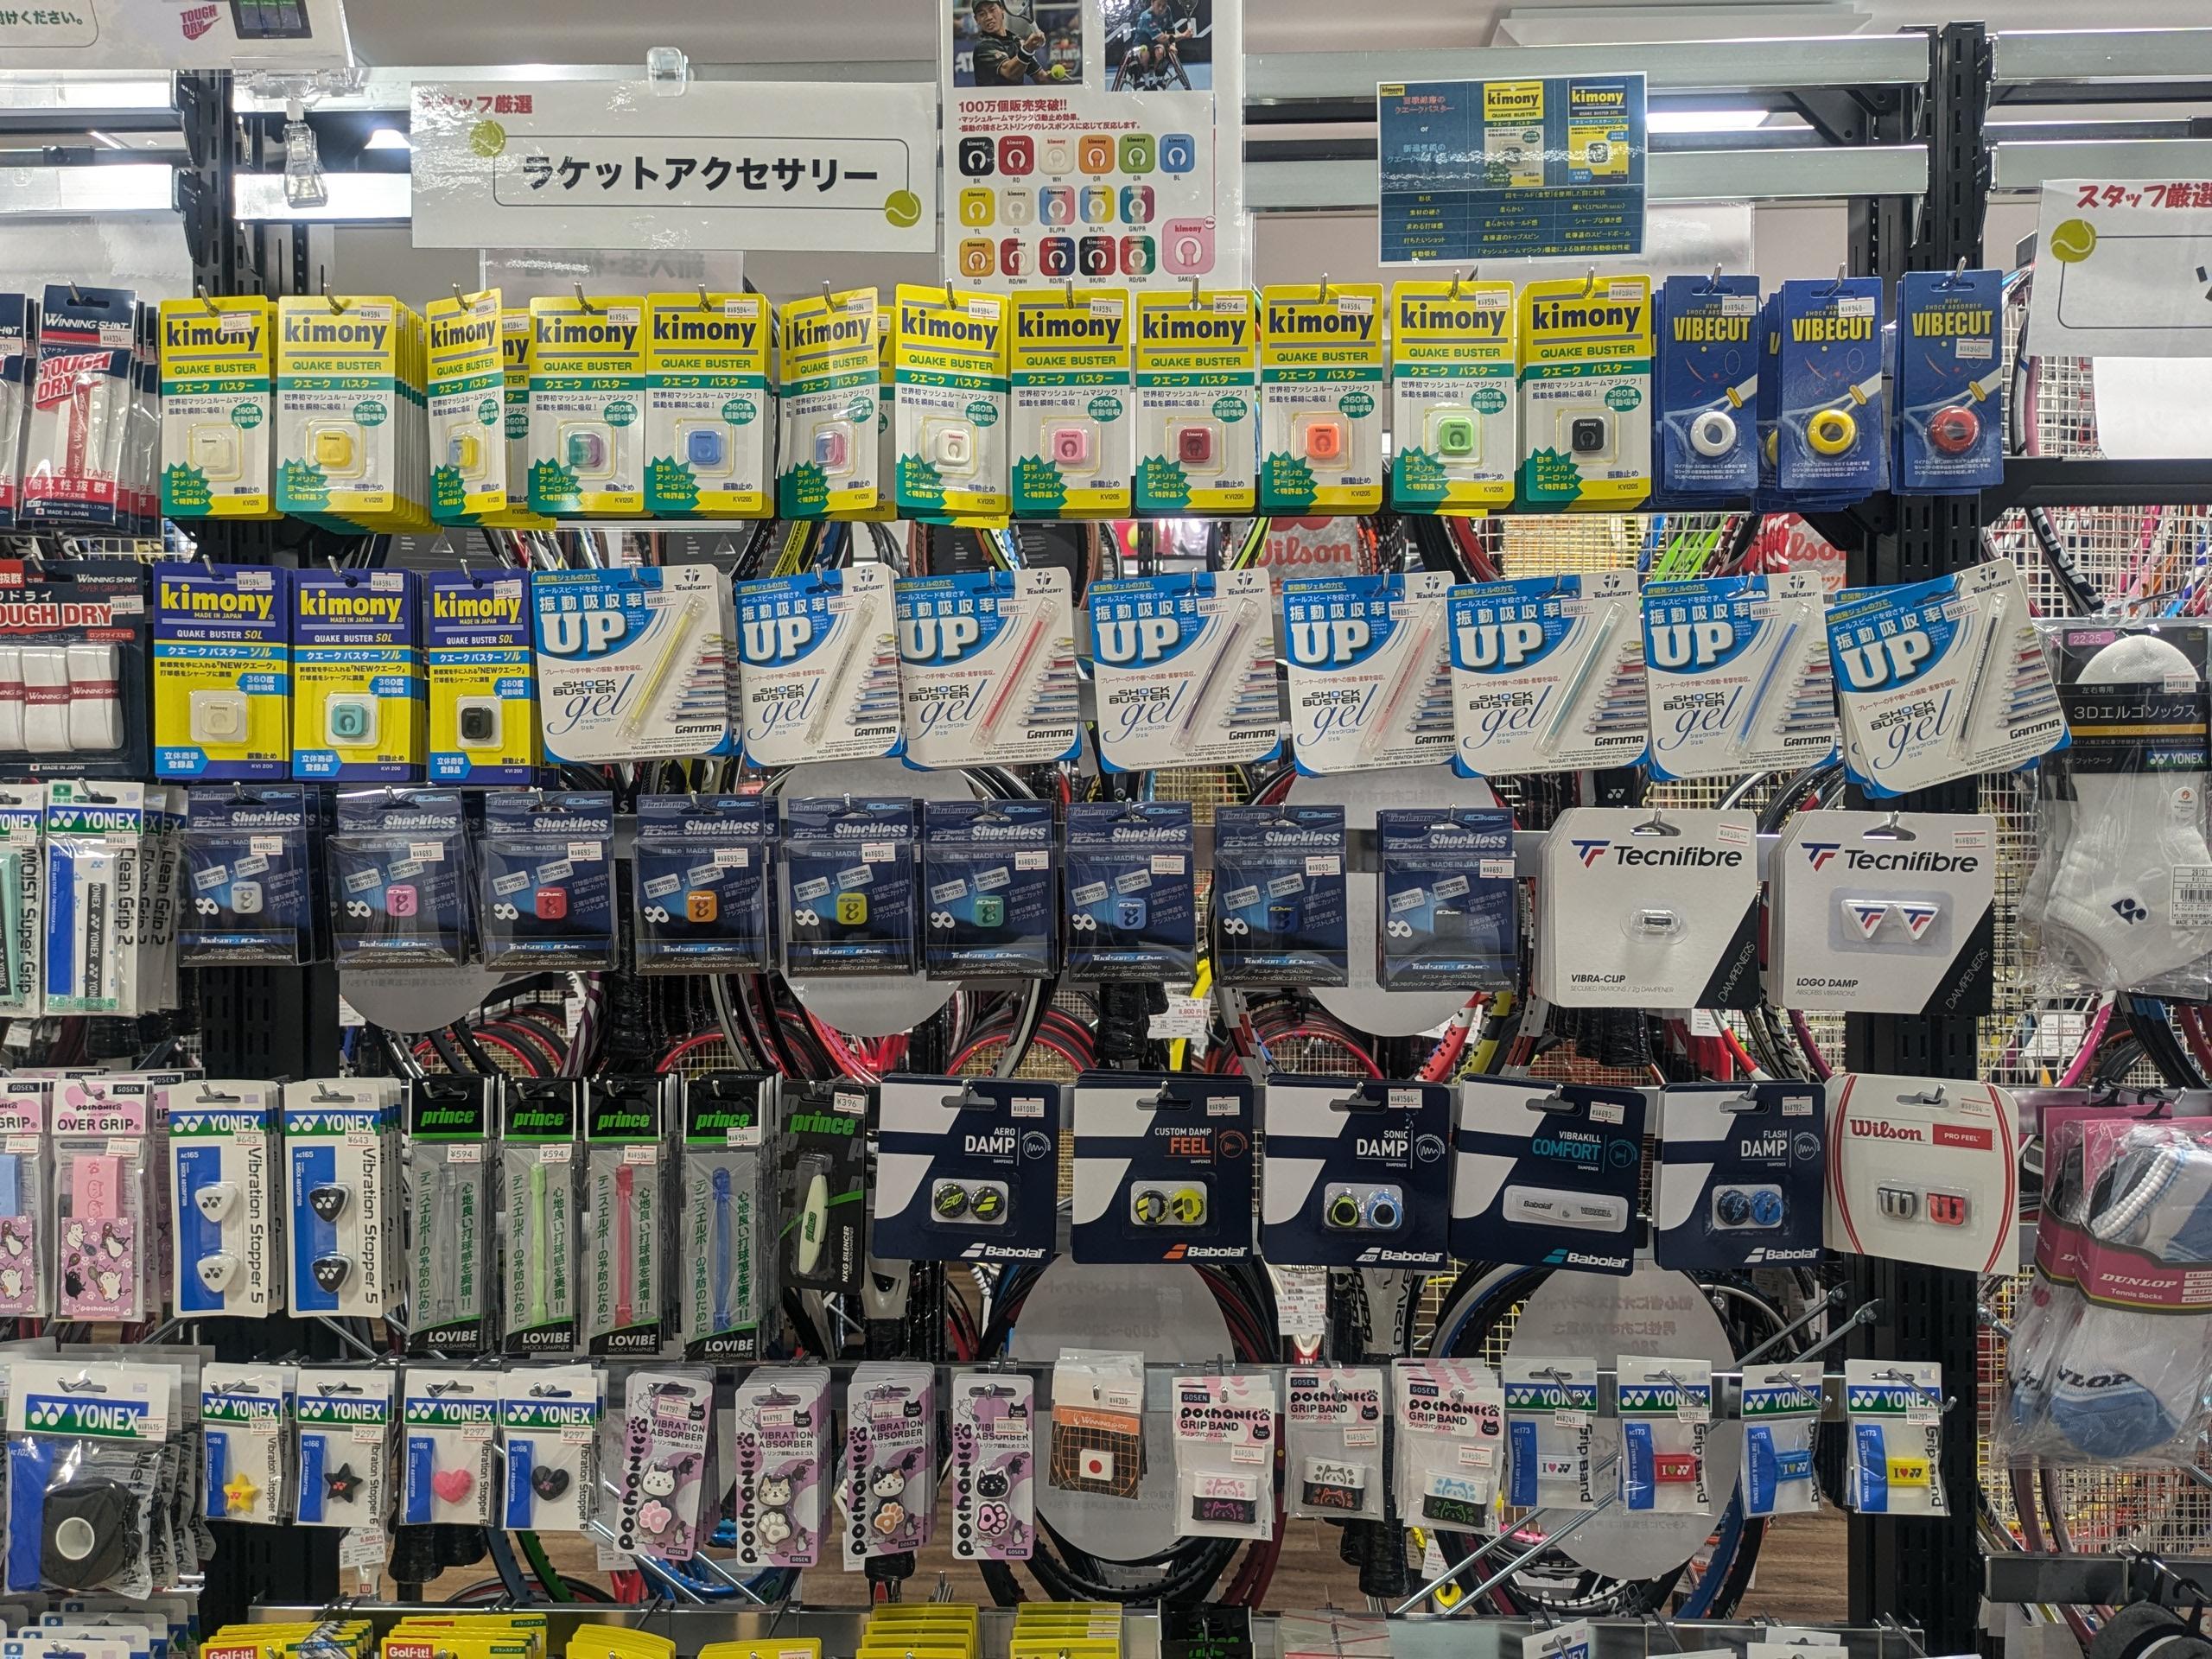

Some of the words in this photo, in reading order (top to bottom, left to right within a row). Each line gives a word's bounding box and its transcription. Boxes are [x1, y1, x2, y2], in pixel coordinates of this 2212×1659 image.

[180, 4, 216, 22] TOUGH
[182, 21, 205, 36] DRY
[522, 156, 878, 193] ラケットアクセサリー
[1268, 308, 1375, 340] kimony
[1401, 302, 1506, 337] kimony
[1533, 303, 1639, 333] kimony
[284, 317, 387, 350] kimony
[537, 318, 638, 350] kimony
[653, 314, 757, 348] kimony
[1018, 311, 1122, 345] kimony
[1142, 313, 1246, 346] kimony
[1674, 317, 1751, 342] VIBECUT
[1792, 316, 1871, 342] VIBECUT
[40, 351, 113, 378] TOUGH
[175, 365, 210, 375] QUAKE
[214, 364, 257, 373] BUSTER
[292, 362, 334, 371] QUAKE
[337, 361, 381, 371] BUSTER
[661, 359, 702, 369] QUAKE
[706, 358, 752, 368] BUSTER
[1151, 357, 1192, 367] QUAKE
[1195, 355, 1242, 366] BUSTER
[1542, 365, 1581, 377] クエーク
[1591, 364, 1632, 375] バスター
[37, 373, 76, 402] DRY
[176, 383, 210, 394] クエーク
[219, 382, 255, 392] バスター
[293, 378, 331, 389] クエーク
[340, 378, 379, 389] バスター
[161, 583, 274, 620] kimony
[301, 590, 397, 622] kimony
[539, 594, 643, 612] 振動吸収率
[1095, 600, 1196, 620] 振動吸収率
[0, 604, 59, 627] OUGH
[63, 604, 112, 626] DRY
[177, 629, 206, 638] QUAKE
[209, 630, 242, 639] BUSTER
[540, 612, 626, 654] UP
[1096, 621, 1180, 663] UP
[1292, 620, 1370, 664] UP
[209, 647, 247, 656] バスター
[1457, 624, 1543, 667] UP
[553, 686, 616, 696] BUSTER
[562, 679, 616, 688] SHOCK
[547, 674, 634, 735] gel
[2074, 703, 2197, 721] 3Dエルゴソックス
[675, 724, 722, 735] GAMMA
[1228, 728, 1276, 740] GAMMA
[2171, 752, 2203, 765] YONEX
[83, 811, 136, 830] YONEX
[384, 815, 457, 830] Shockless
[533, 817, 607, 833] Shockless
[683, 819, 760, 836] Shockless
[1614, 845, 1742, 867] Tecnifibre
[1844, 849, 1979, 874] Tecnifibre
[21, 849, 36, 901] MOIST
[118, 848, 136, 893] Clean
[114, 898, 135, 929] Grip
[122, 935, 135, 945] 2
[1570, 974, 1626, 983] VIBRA-CLIP
[1717, 941, 1757, 1002] DAMPENERS
[1796, 977, 1825, 987] LOGO
[1827, 978, 1859, 988] DAMP
[836, 1097, 857, 1107] ¥396
[58, 1118, 95, 1130] OVER
[99, 1118, 134, 1130] GRIP
[208, 1114, 259, 1132] YONEX
[420, 1107, 474, 1127] prince
[597, 1111, 650, 1129] prince
[236, 1135, 257, 1144] ¥643
[994, 1128, 1015, 1136] AERO
[1188, 1128, 1212, 1136] DAMP
[1383, 1130, 1408, 1139] SONIC
[1559, 1131, 1601, 1143] VIBRAKILL
[1849, 1119, 1923, 1142] Wilson
[1961, 1134, 1979, 1142] FEEL
[450, 1149, 473, 1158] ¥594
[964, 1135, 1015, 1154] DAMP
[1170, 1137, 1211, 1154] FEEL
[1356, 1138, 1408, 1157] DAMP
[1532, 1139, 1601, 1160] COMFORT
[1741, 1141, 1787, 1157] DAMP
[248, 1147, 262, 1218] Vibration
[248, 1224, 264, 1287] Stopper
[984, 1245, 1046, 1258] Babolat
[2099, 1273, 2178, 1289] DUNLOP
[251, 1294, 264, 1303] 5
[2110, 1288, 2137, 1299] Tennis
[428, 1330, 478, 1342] LOVIBE
[1184, 1393, 1208, 1402] GOSEN
[330, 1403, 382, 1421] YONEX
[539, 1407, 592, 1424] YONEX
[1290, 1404, 1316, 1413] GRIP
[1319, 1404, 1347, 1414] BAND
[355, 1430, 377, 1439] ¥297
[652, 1419, 705, 1433] VIBRATION
[1180, 1420, 1206, 1430] GRIP
[1208, 1420, 1238, 1431] BAND
[650, 1429, 703, 1442] ABSORBER
[1927, 1427, 1938, 1455] Grip
[481, 1440, 490, 1475] Vibration
[480, 1478, 489, 1512] Stopper
